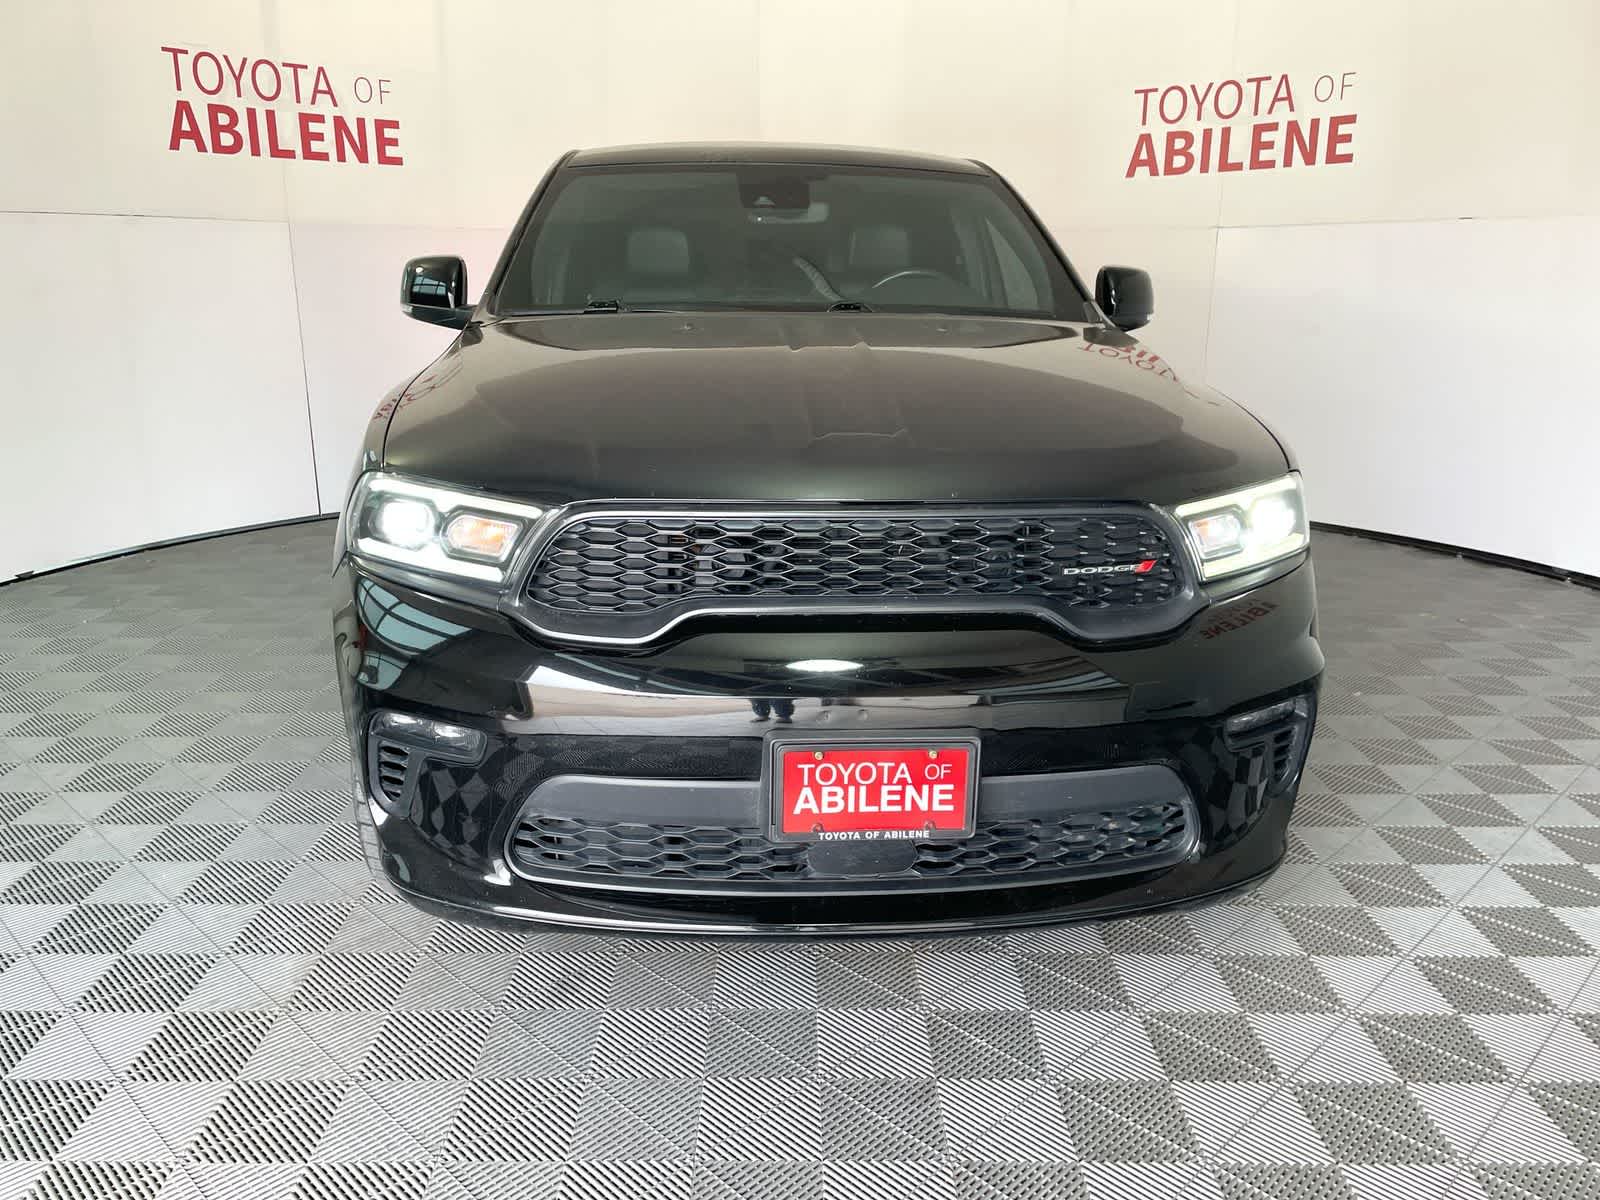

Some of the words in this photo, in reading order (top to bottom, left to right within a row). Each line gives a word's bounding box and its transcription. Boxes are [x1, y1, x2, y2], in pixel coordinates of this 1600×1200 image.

[161, 46, 338, 107] TOYOTA
[354, 76, 391, 104] OF
[1134, 74, 1295, 126] TOYOTA
[1314, 72, 1356, 102] OF
[169, 100, 403, 166] ABILENE
[1125, 114, 1357, 178] ABILENE
[1063, 563, 1141, 575] DODGE
[797, 762, 912, 786] TOYOTA
[924, 763, 953, 780] OF
[793, 784, 954, 814] ABILENE
[818, 831, 861, 841] TOYOTA
[864, 831, 880, 839] OF
[884, 830, 930, 840] ABILENE
